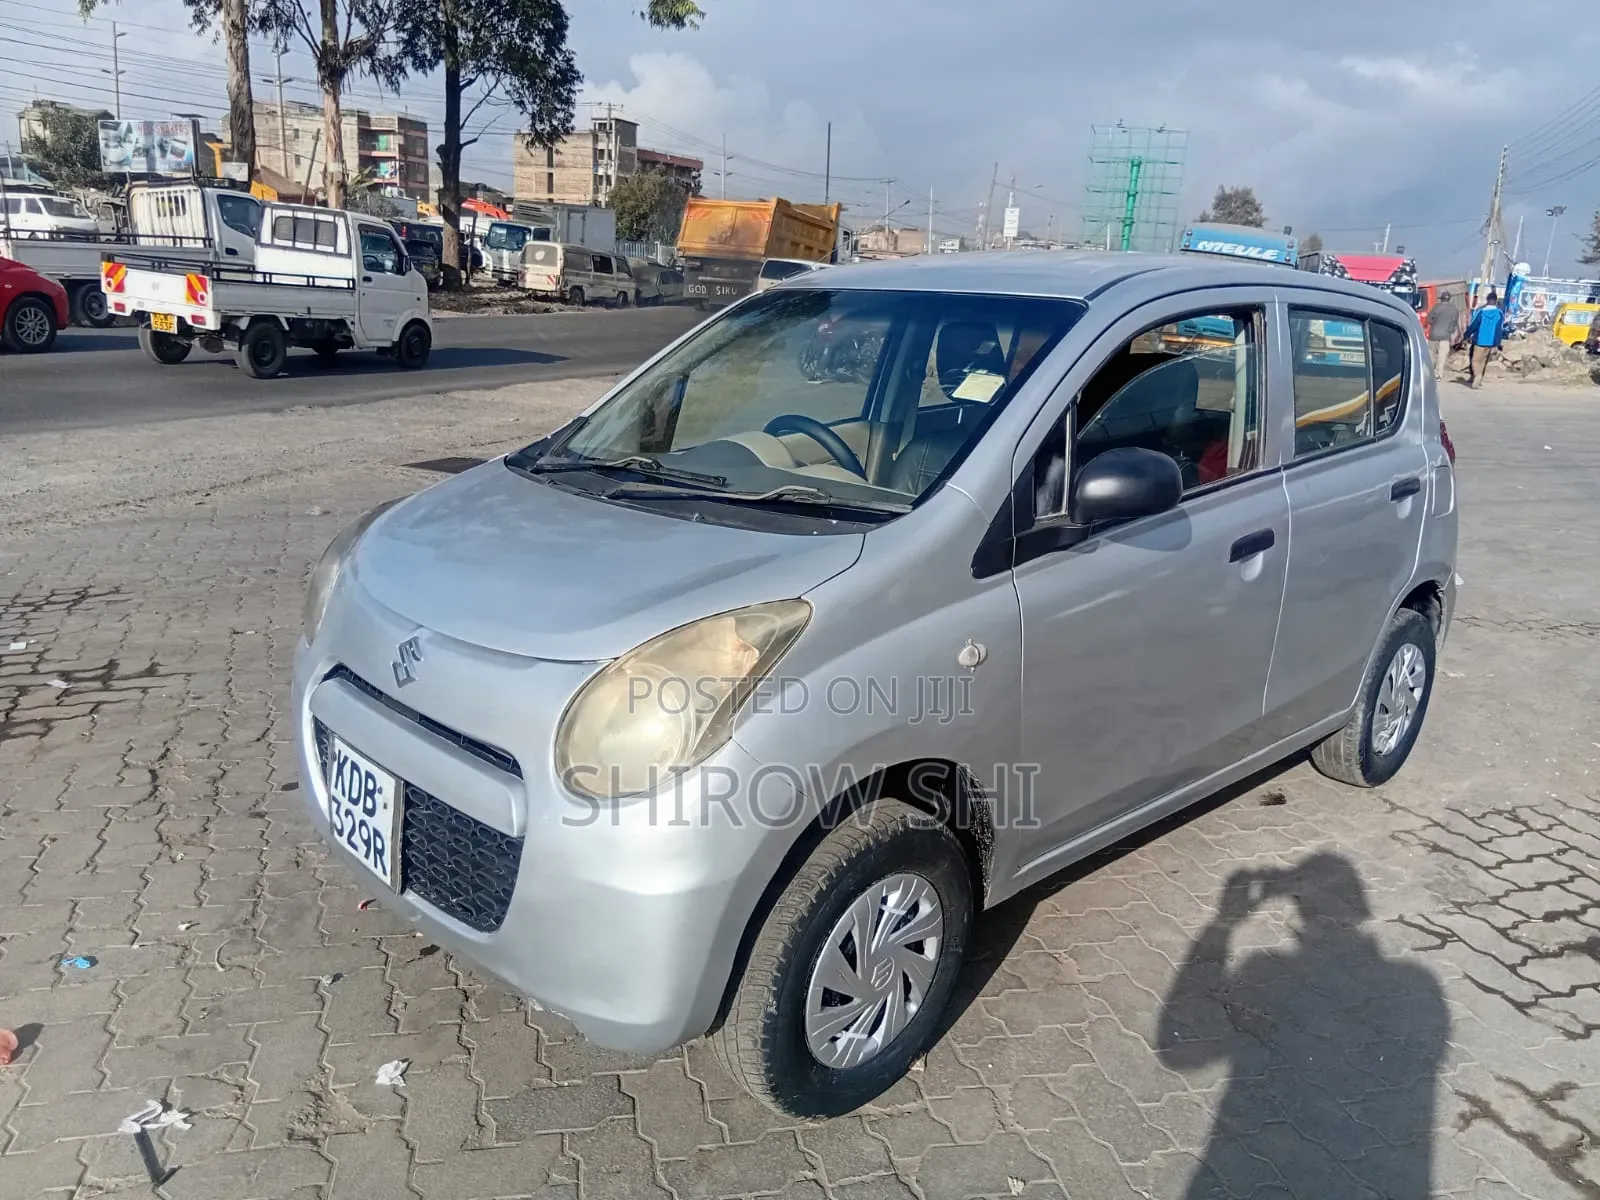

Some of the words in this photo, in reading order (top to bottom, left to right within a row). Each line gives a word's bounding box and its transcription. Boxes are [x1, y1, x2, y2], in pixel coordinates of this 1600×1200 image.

[688, 284, 707, 295] GOD
[334, 748, 377, 818] KDB
[331, 794, 388, 877] 329R
